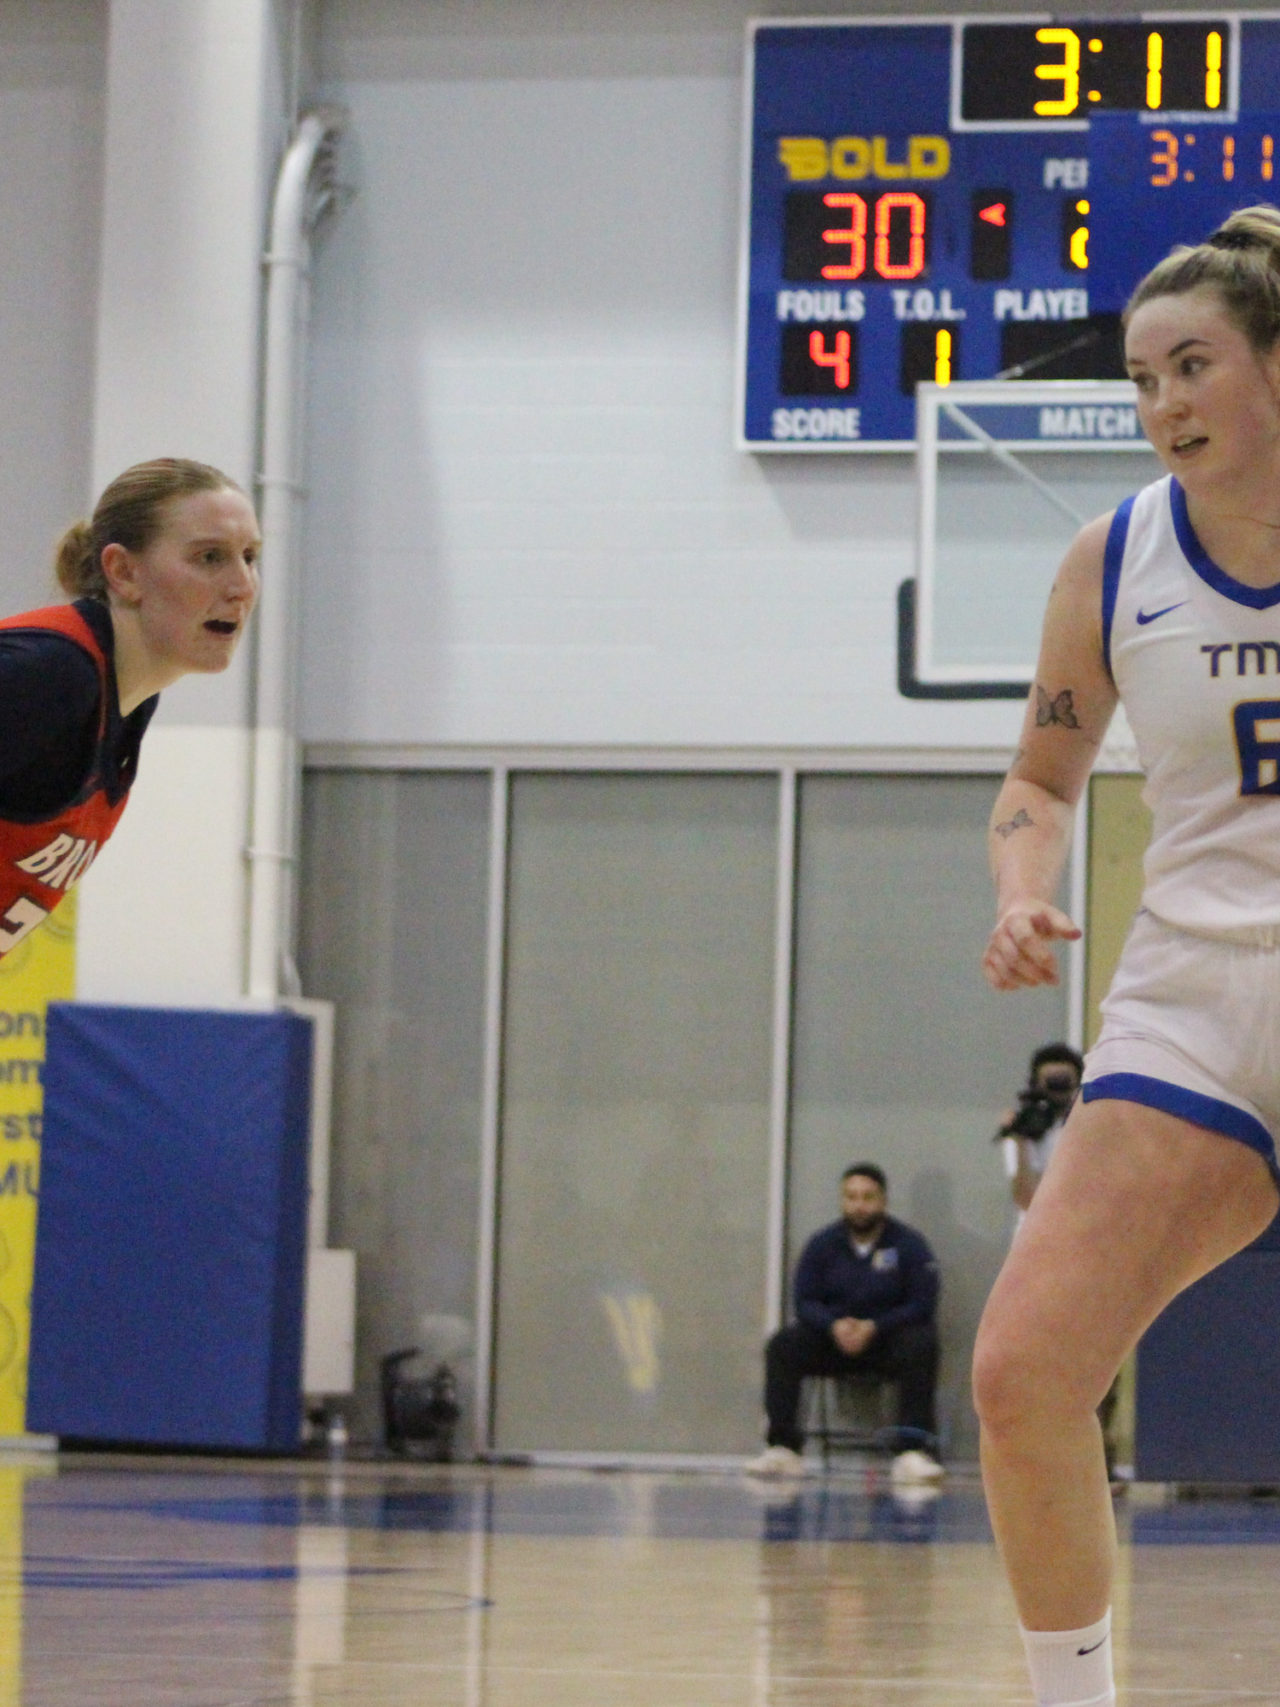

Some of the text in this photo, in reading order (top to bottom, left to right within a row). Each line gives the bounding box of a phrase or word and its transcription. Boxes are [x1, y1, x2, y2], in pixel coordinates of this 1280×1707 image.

[1034, 28, 1222, 116] 3:11
[779, 134, 950, 181] BOLD
[1151, 130, 1274, 187] 3:11
[821, 192, 926, 279] 30
[777, 289, 866, 322] FOULS
[890, 288, 967, 321] T.O.L.
[809, 330, 850, 389] 4
[935, 328, 952, 389] 1
[772, 407, 861, 440] SCORE
[1040, 407, 1137, 439] MATCH
